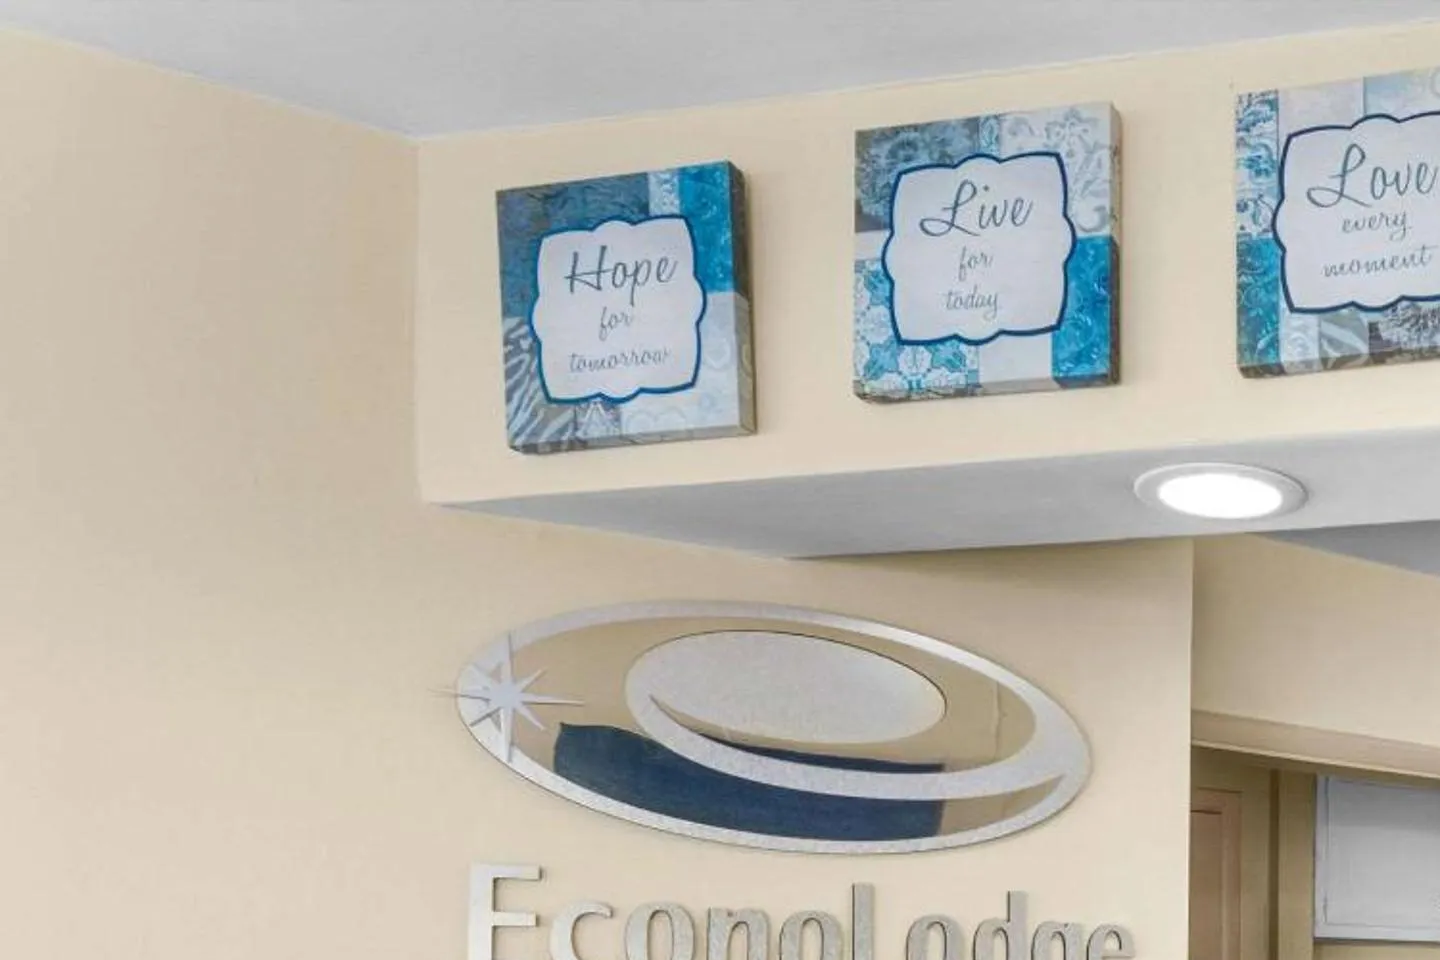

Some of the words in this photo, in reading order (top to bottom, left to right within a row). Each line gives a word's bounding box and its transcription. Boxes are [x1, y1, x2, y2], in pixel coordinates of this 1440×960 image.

[1306, 143, 1440, 208] Love
[919, 179, 1033, 237] Live
[1341, 212, 1413, 241] every
[563, 245, 679, 307] Hope
[958, 247, 993, 281] for
[1321, 244, 1439, 278] moment
[943, 284, 1000, 320] today
[598, 306, 635, 342] for
[569, 350, 671, 373] tomorrow
